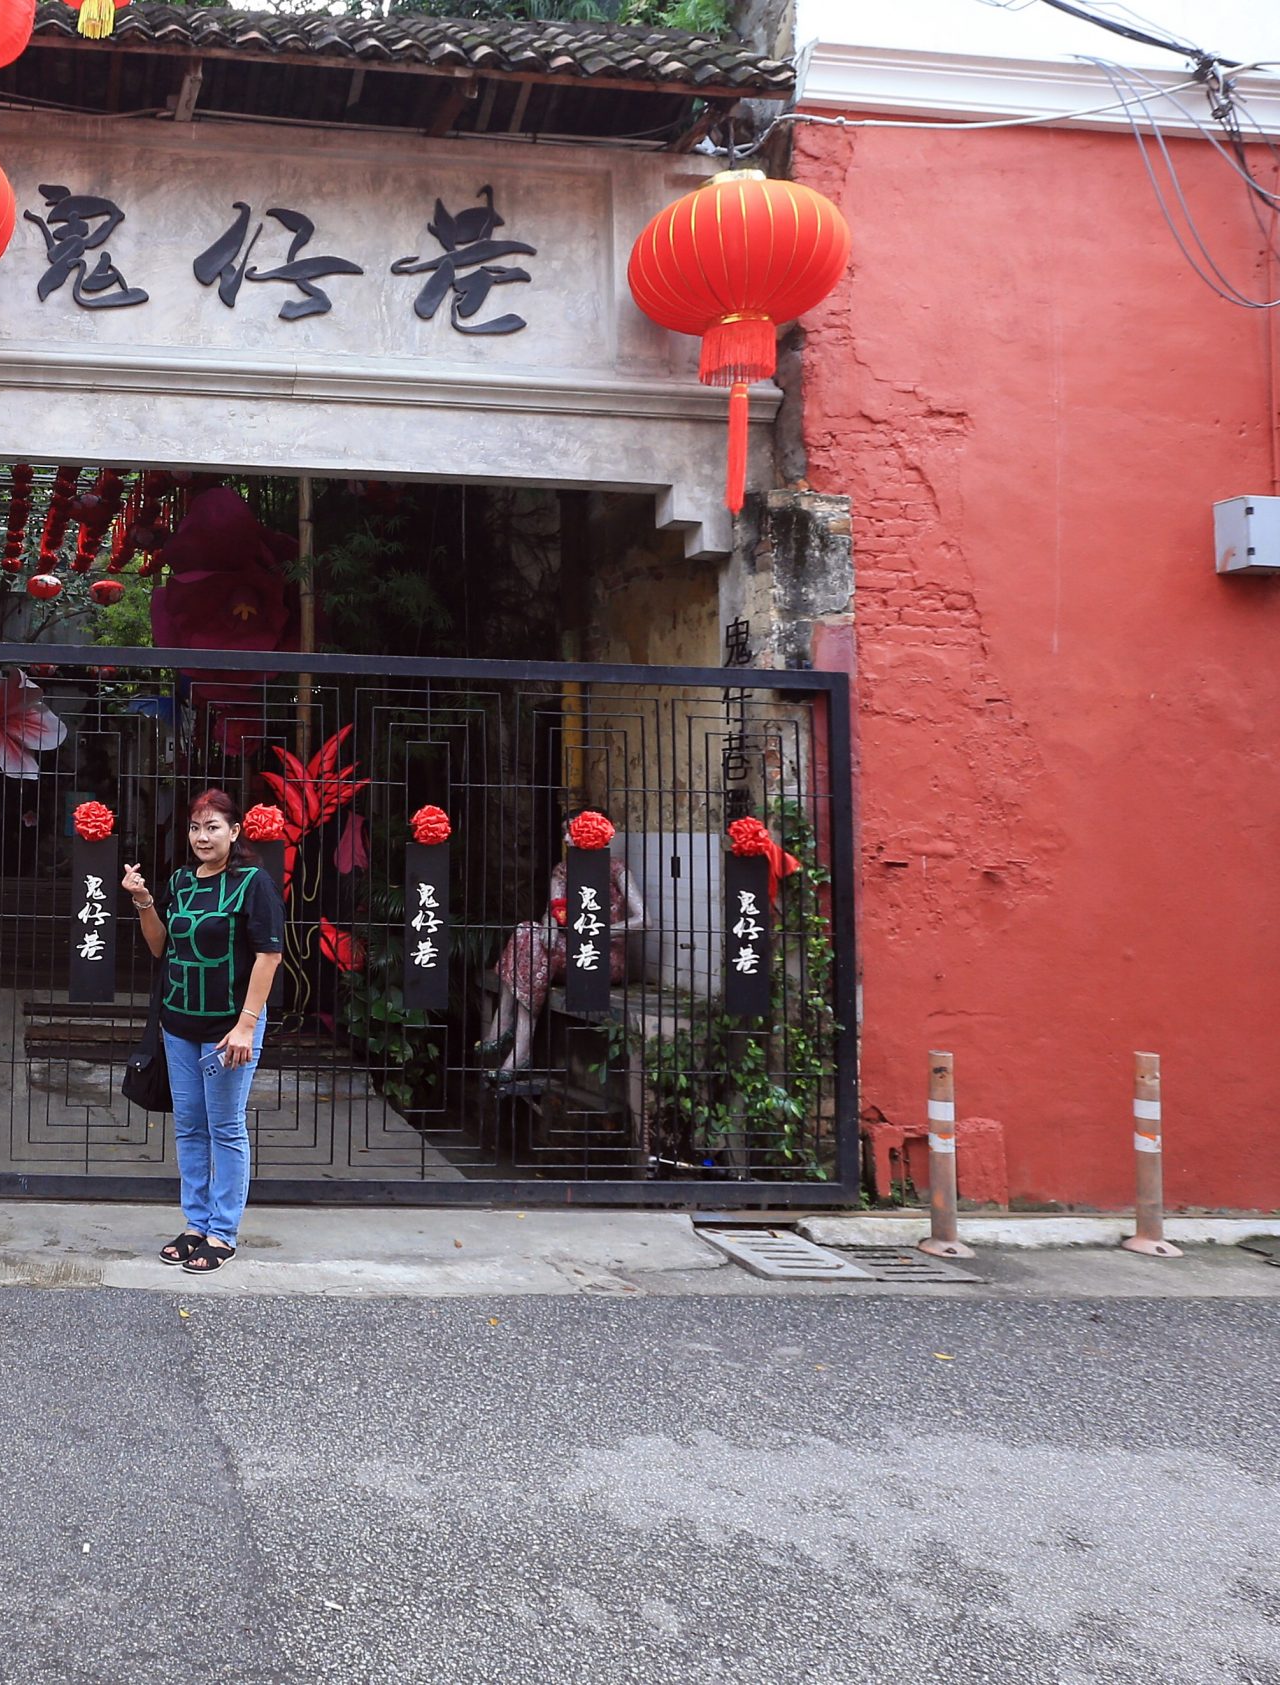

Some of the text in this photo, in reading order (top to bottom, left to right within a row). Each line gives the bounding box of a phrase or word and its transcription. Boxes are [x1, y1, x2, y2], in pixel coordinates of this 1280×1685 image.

[23, 183, 538, 335] 鬼仔巷
[76, 874, 112, 961] 鬼仔巷
[410, 882, 444, 968] 鬼仔巷
[572, 886, 606, 971] 鬼仔巷
[732, 889, 764, 975] 鬼仔巷
